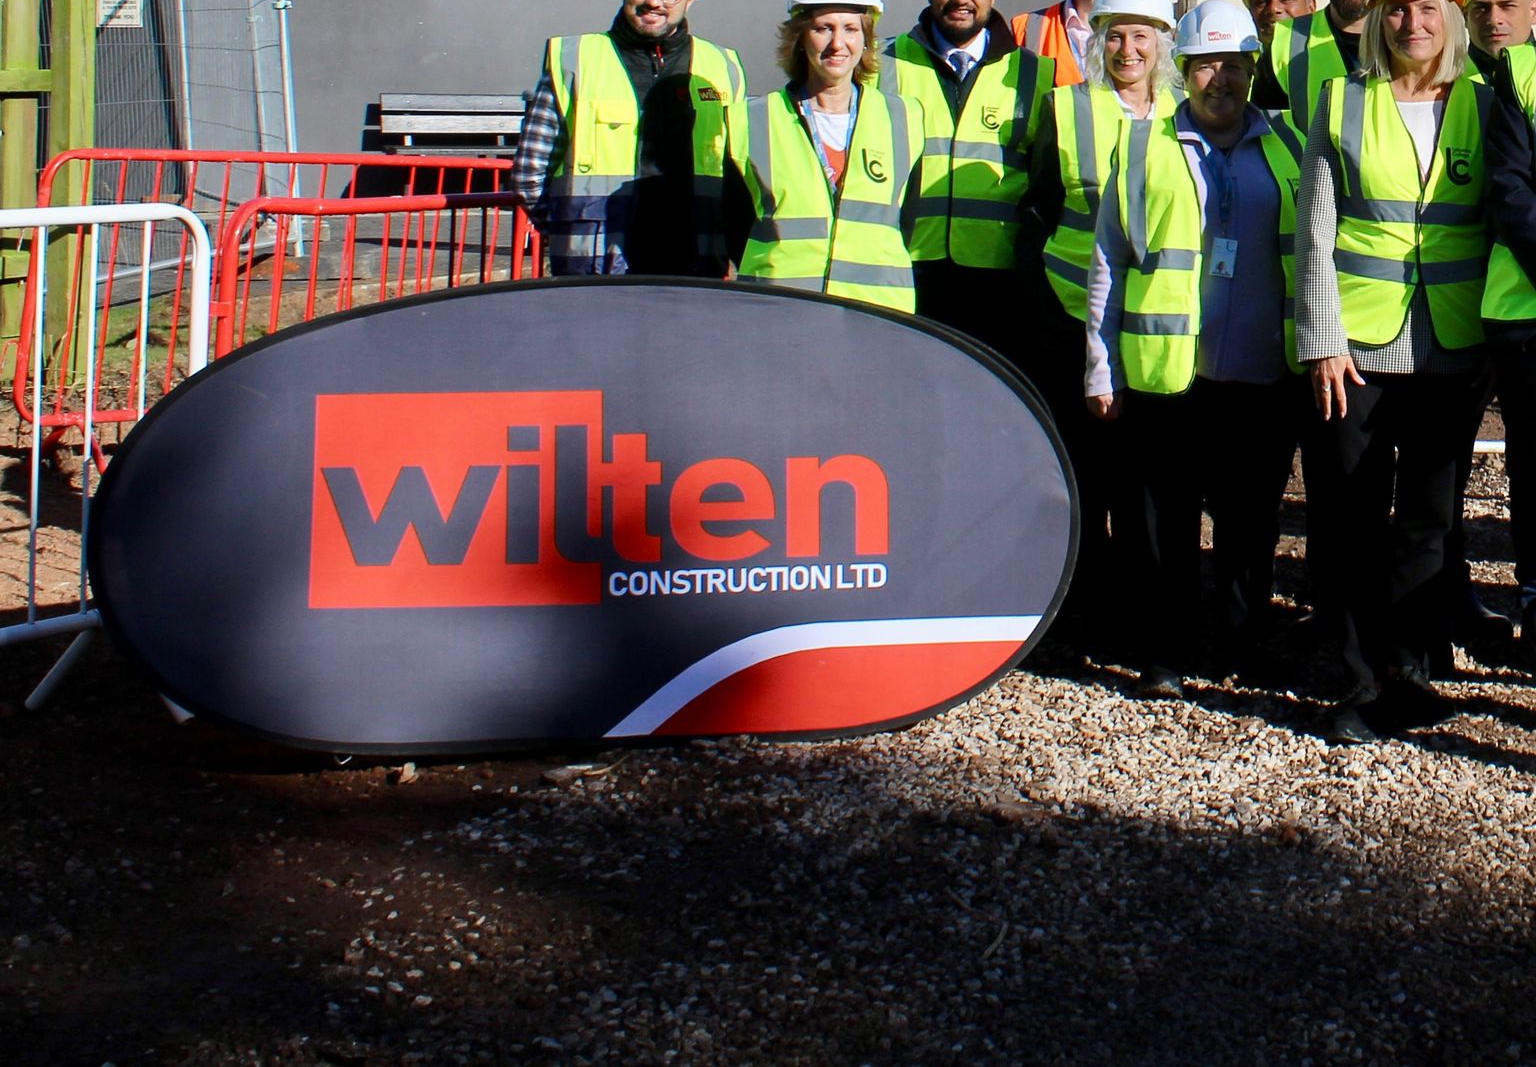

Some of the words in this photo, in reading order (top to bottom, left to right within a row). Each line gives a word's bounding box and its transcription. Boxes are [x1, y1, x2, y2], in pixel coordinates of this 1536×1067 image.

[320, 424, 889, 566] wilten
[609, 564, 831, 596] CONSTRUCTION
[836, 562, 888, 589] LTD
